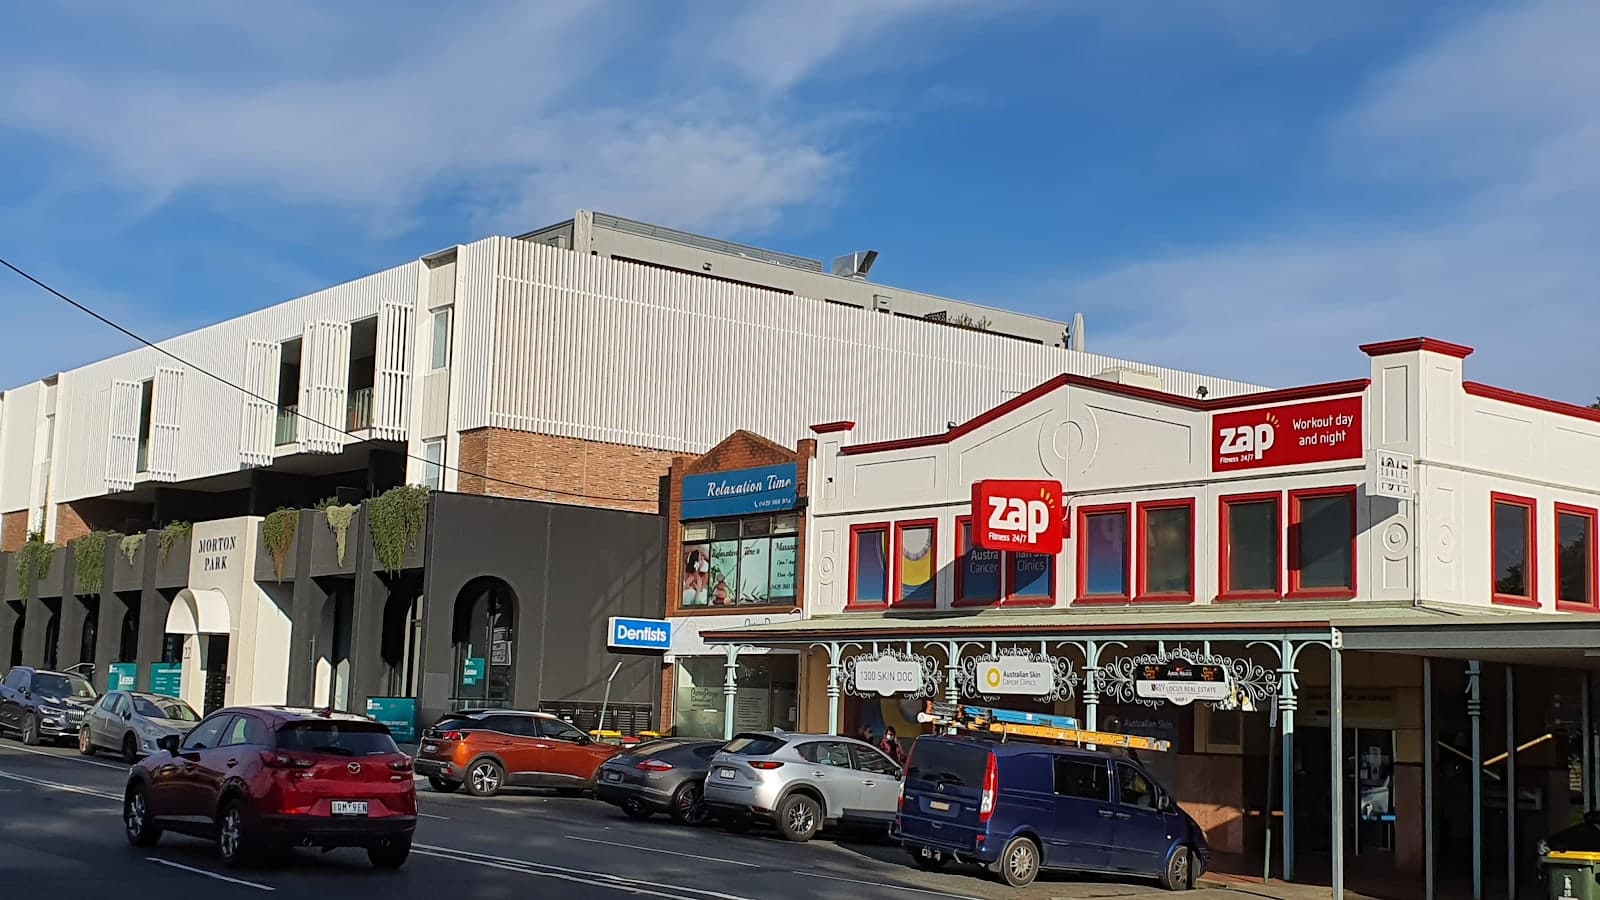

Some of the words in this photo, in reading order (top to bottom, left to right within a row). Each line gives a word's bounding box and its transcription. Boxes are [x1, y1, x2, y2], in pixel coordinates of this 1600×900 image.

[1292, 415, 1334, 430] Workout
[1336, 413, 1354, 429] day
[1219, 425, 1274, 460] zap
[1298, 431, 1317, 446] and
[1319, 430, 1347, 447] night
[1219, 455, 1239, 464] Fitness
[1240, 454, 1254, 463] 24/7
[707, 480, 762, 497] Relaxation
[767, 474, 791, 490] Time
[988, 496, 1049, 544] zap
[198, 536, 237, 553] MORTON
[988, 532, 1011, 542] Fitness
[1012, 533, 1027, 544] 24/7
[204, 555, 228, 571] PARK
[970, 562, 998, 573] Cancer
[1017, 559, 1045, 572] Clinics
[617, 624, 667, 643] Dentists
[860, 671, 876, 681] 1300
[877, 671, 895, 681] SKIN
[897, 671, 913, 682] DOC
